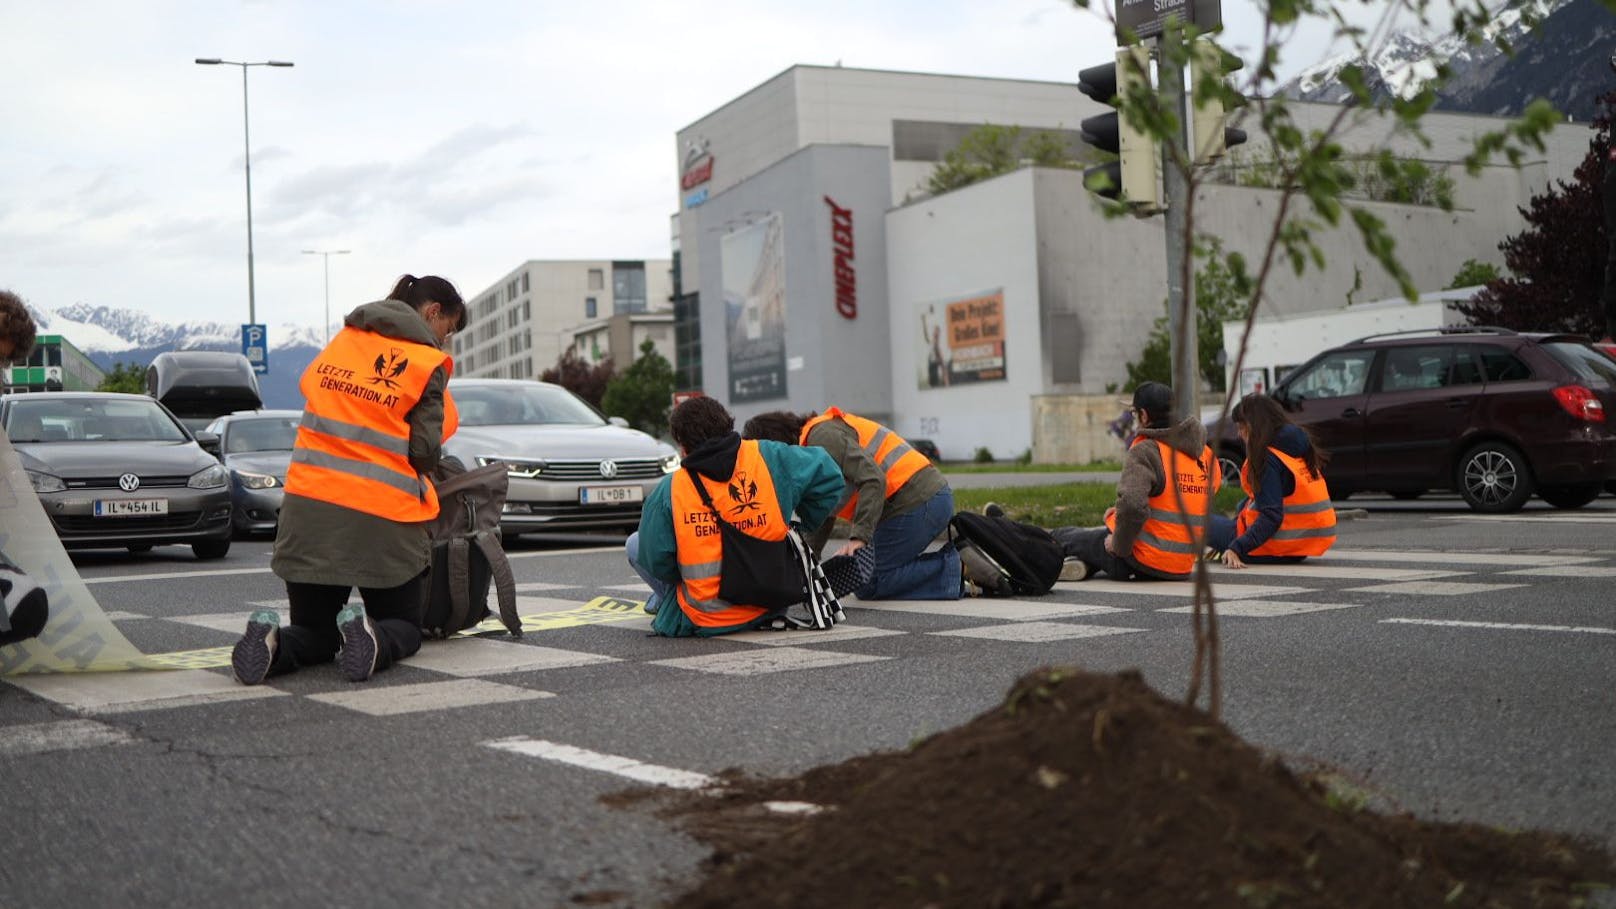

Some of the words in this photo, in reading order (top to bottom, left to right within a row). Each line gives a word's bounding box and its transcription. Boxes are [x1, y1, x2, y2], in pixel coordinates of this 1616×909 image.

[824, 195, 857, 321] CINEPLEXX
[316, 362, 355, 380] LETZTE
[320, 376, 400, 409] GENERATION.AT
[1174, 473, 1194, 483] ETZTE
[108, 503, 118, 513] IL
[127, 502, 148, 513] 454
[151, 501, 161, 512] IL
[683, 511, 718, 524] LETZ
